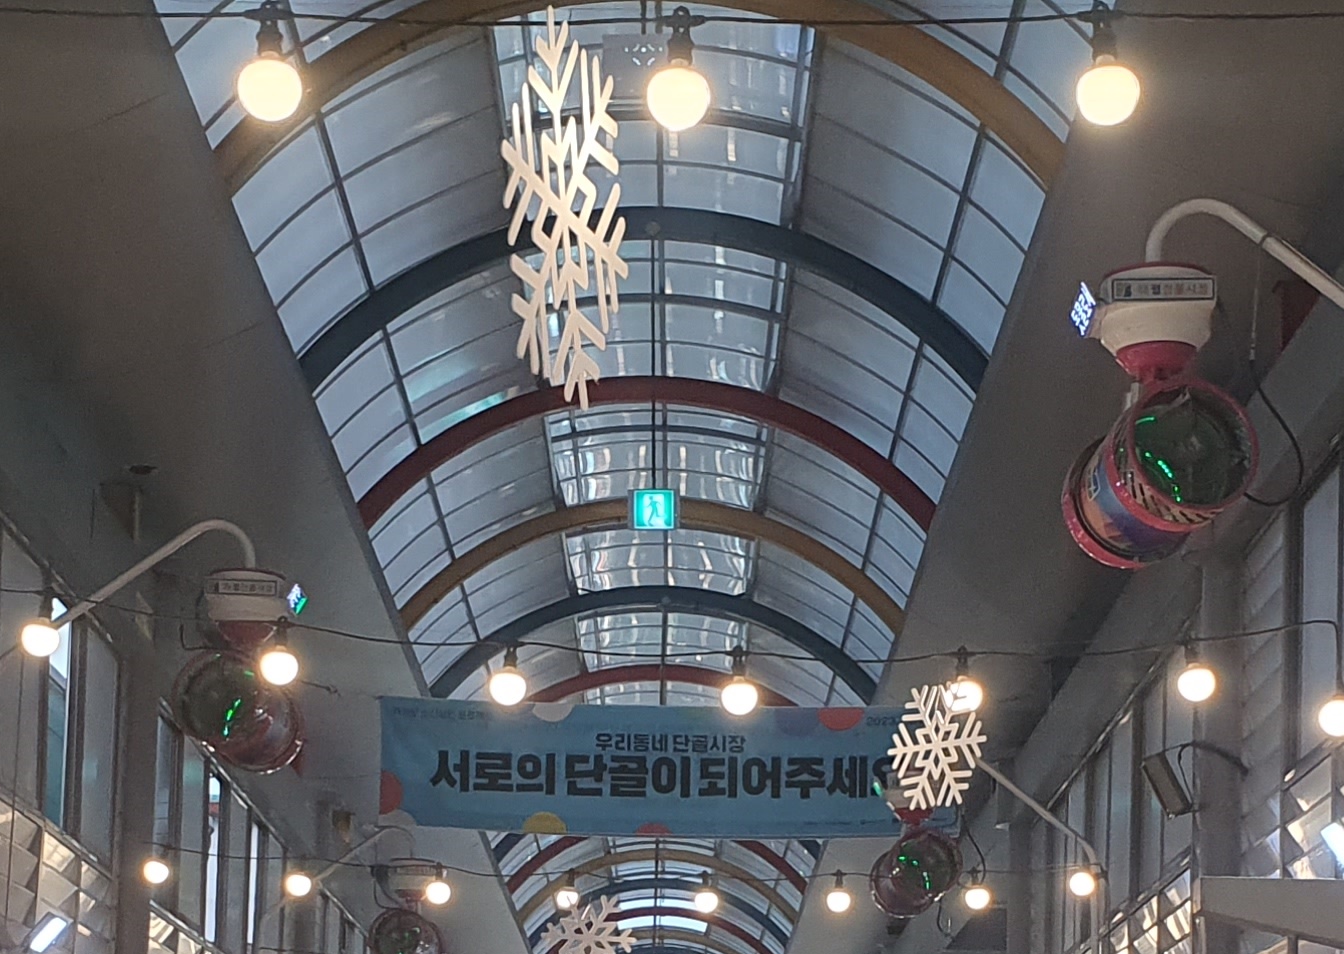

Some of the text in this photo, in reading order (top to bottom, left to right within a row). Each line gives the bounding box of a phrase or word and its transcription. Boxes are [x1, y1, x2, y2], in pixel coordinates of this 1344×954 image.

[595, 733, 746, 753] 우리동네 단골시장
[430, 750, 557, 795] 서로의
[564, 754, 691, 798] 단골이
